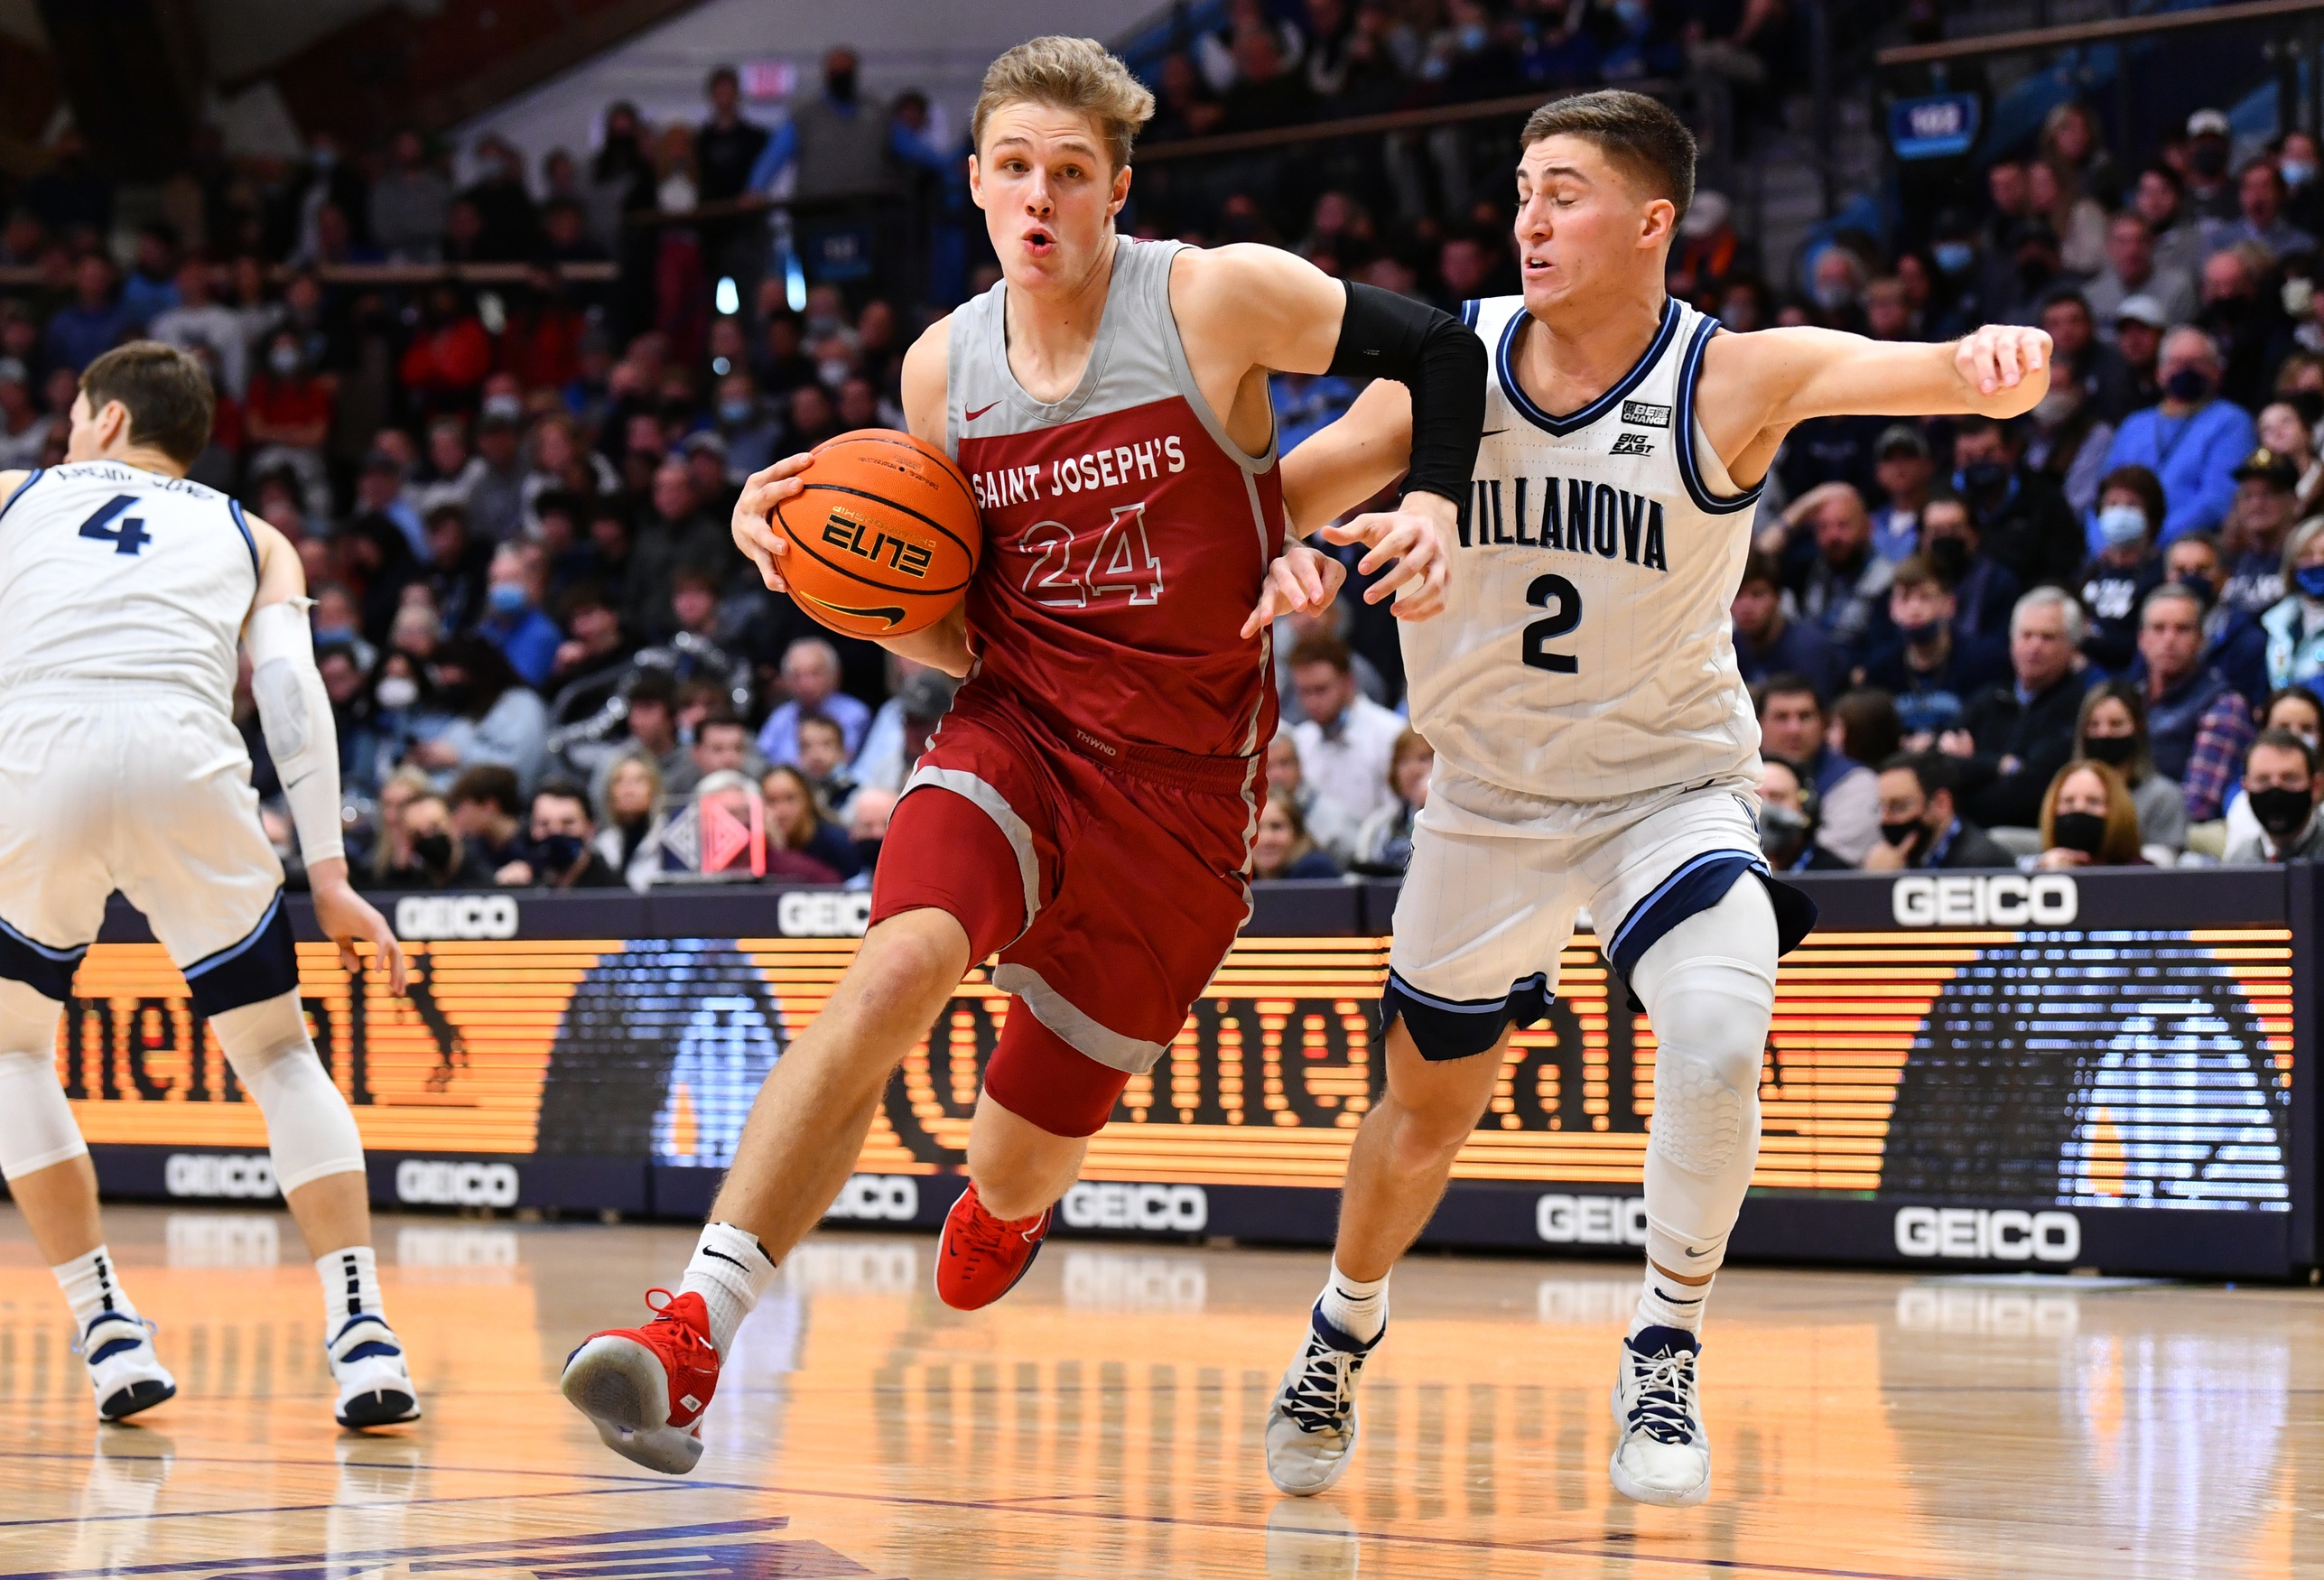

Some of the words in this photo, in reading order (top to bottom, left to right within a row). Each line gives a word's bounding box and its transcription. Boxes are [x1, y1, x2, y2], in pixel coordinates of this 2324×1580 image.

[1617, 433, 1649, 444] BIG
[1622, 413, 1668, 425] CHANGE
[972, 464, 1040, 509] SAINT
[1051, 435, 1185, 497] JOSEPH'S
[1612, 442, 1655, 453] EAST
[79, 495, 152, 555] 4
[822, 513, 934, 579] ELITE
[1456, 474, 1669, 572] VILLANOVA
[1018, 501, 1165, 608] 24
[1522, 573, 1583, 674] 2
[1076, 729, 1117, 757] THWND
[395, 895, 519, 940] GEICO
[777, 891, 873, 938] GEIC
[1892, 874, 2078, 926] GEICO
[395, 1160, 519, 1207] GEICO
[1062, 1181, 1208, 1231] GEICO
[1536, 1193, 1648, 1246] GEIC
[1894, 1206, 2081, 1262] GEICO
